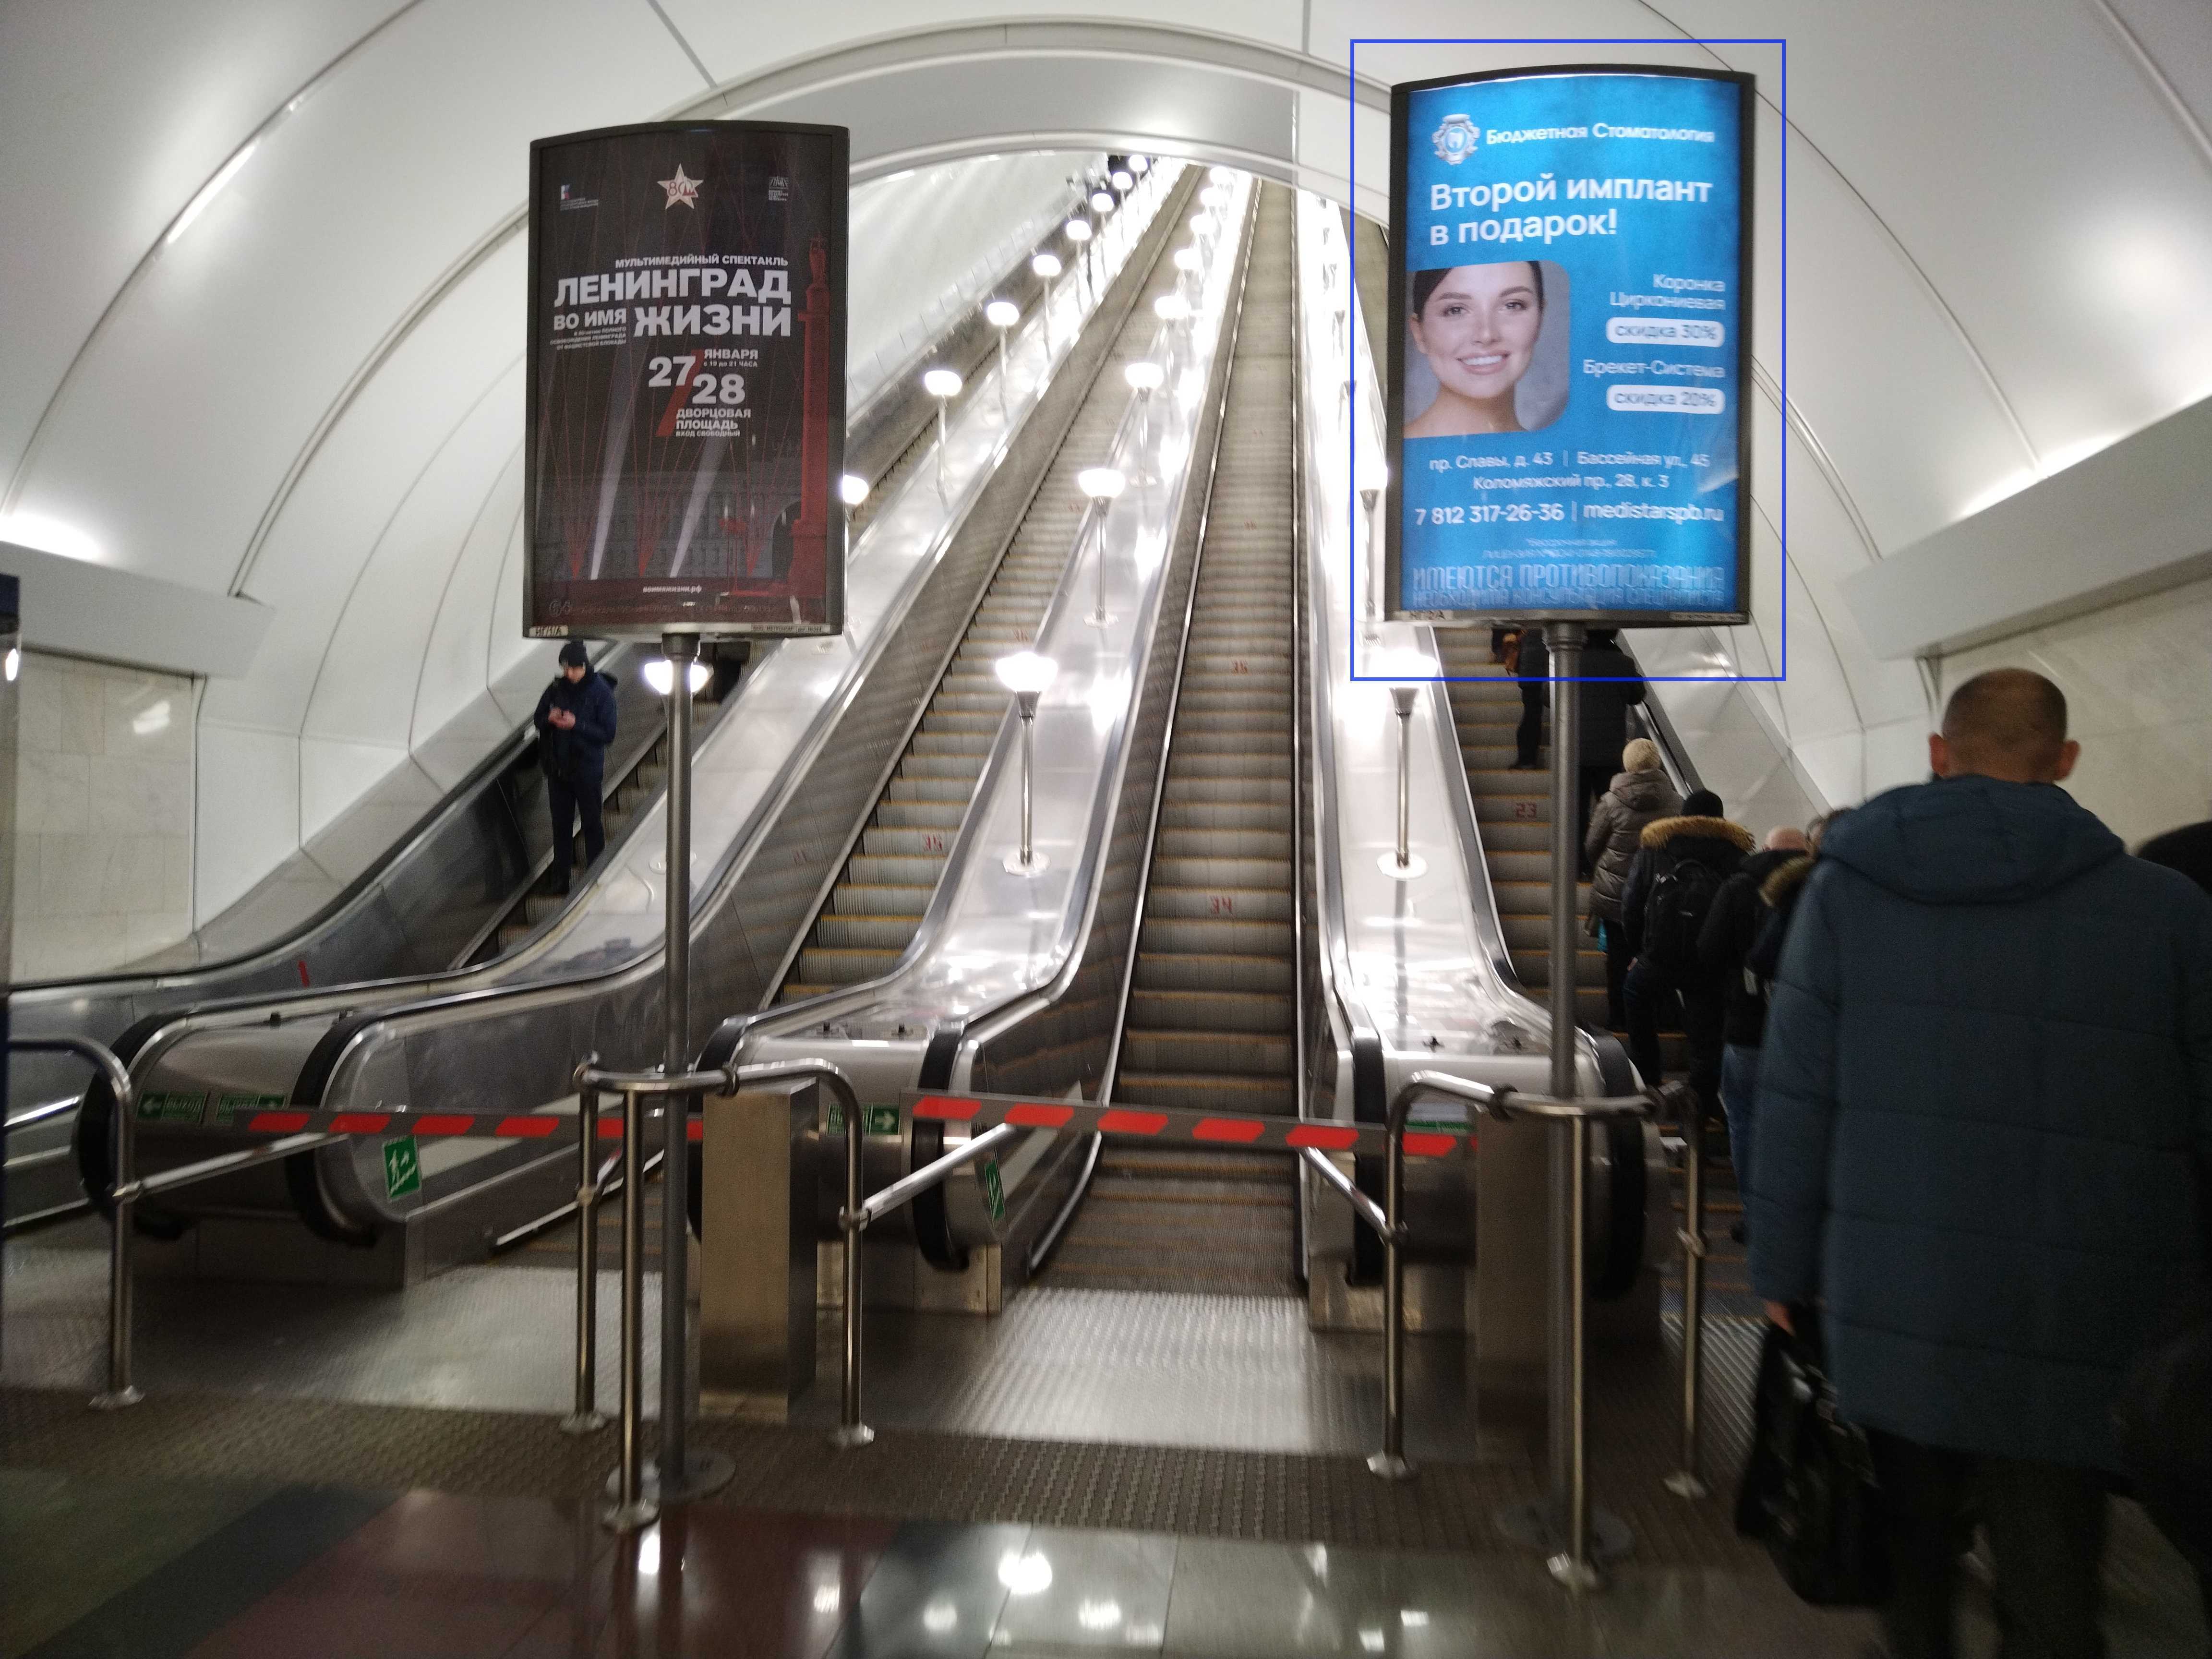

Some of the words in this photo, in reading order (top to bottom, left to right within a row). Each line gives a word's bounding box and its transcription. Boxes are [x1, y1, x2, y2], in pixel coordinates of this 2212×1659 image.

[1487, 127, 1588, 145] Бюджетная
[1593, 123, 1715, 143] Стоматология
[1430, 173, 1556, 210] Второй
[1567, 178, 1712, 203] имплант
[1430, 225, 1449, 246] в
[1459, 208, 1617, 244] подарок!
[615, 254, 719, 268] МУЛЬТИМЕДИЙНЫЙ
[722, 254, 788, 266] СПЕКТАКЛЬ
[554, 268, 792, 308] ЛЕНИНГРАД
[1653, 273, 1725, 292] Коронка
[1610, 292, 1725, 310] Циркониевая
[554, 313, 579, 330] ВО
[584, 308, 626, 327] ИМЯ
[633, 304, 791, 337] ЖИЗНИ
[1615, 325, 1675, 341] скидка
[1681, 324, 1717, 340] 30%
[704, 349, 758, 360] ЯНВАРЯ
[649, 356, 696, 387] 27
[1583, 359, 1725, 379] Брекет-Система
[692, 373, 745, 405] 28
[1614, 392, 1674, 408] скидка
[1680, 391, 1717, 408] 20%
[676, 408, 751, 420] ДВОРЦОВАЯ
[676, 420, 738, 431] ПЛОЩАДЬ
[1430, 458, 1452, 474] пр.
[1532, 451, 1553, 466] 43
[1577, 449, 1662, 467] Бассейная
[1690, 453, 1710, 468] 45
[1473, 472, 1582, 490] Коломяжский
[1657, 473, 1670, 488] 3
[1415, 508, 1426, 525] 7
[1432, 505, 1464, 524] 812
[1469, 503, 1564, 523] 317-26-36
[1583, 501, 1724, 526] medistarspb.ru
[1413, 565, 1513, 592] ИМЕЮТСЯ
[1515, 803, 1538, 819] 23
